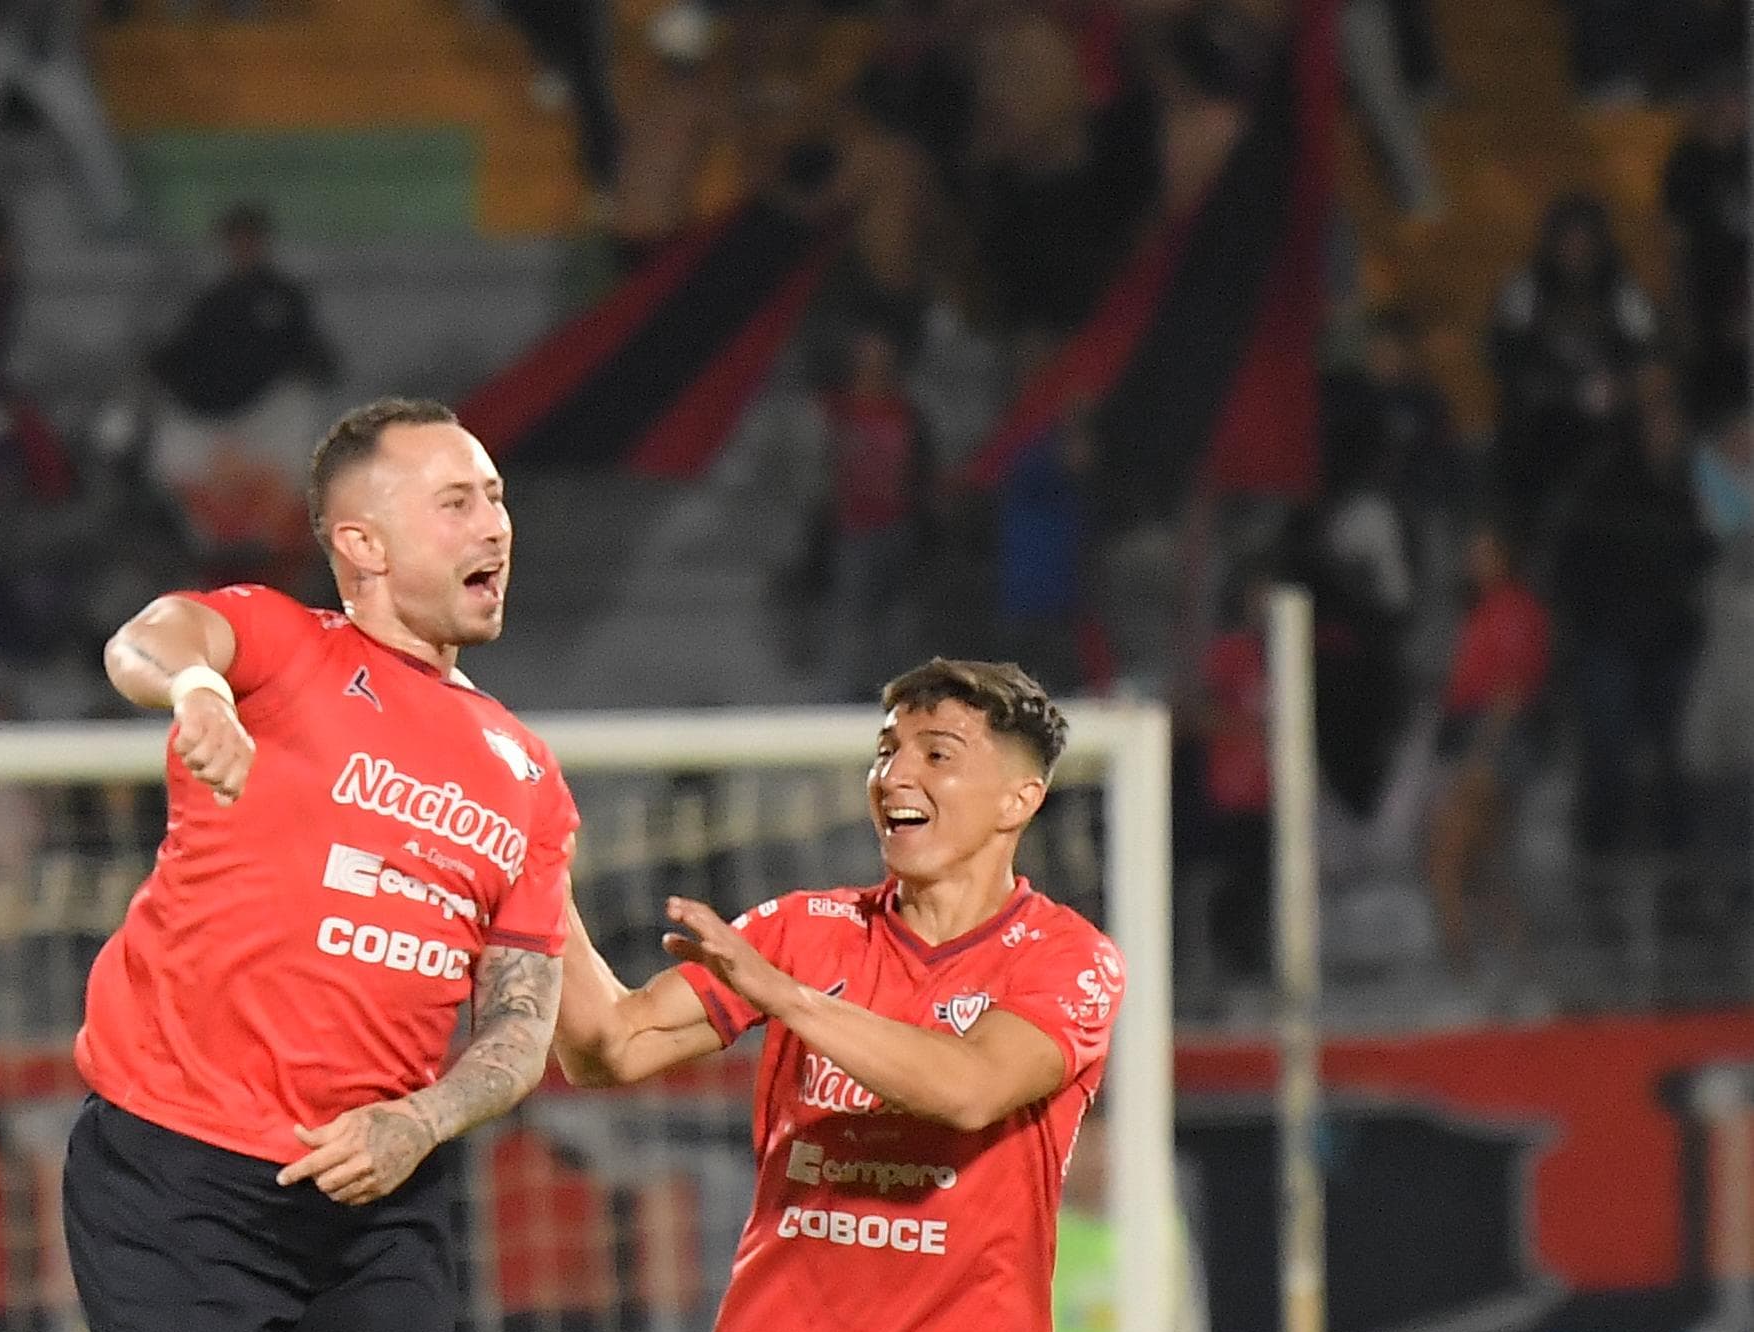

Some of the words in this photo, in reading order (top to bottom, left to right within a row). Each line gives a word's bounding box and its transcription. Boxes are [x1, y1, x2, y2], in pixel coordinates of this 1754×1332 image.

[331, 752, 528, 886] Naciona
[316, 916, 472, 981] COBOC
[777, 1205, 948, 1256] COBOCE
